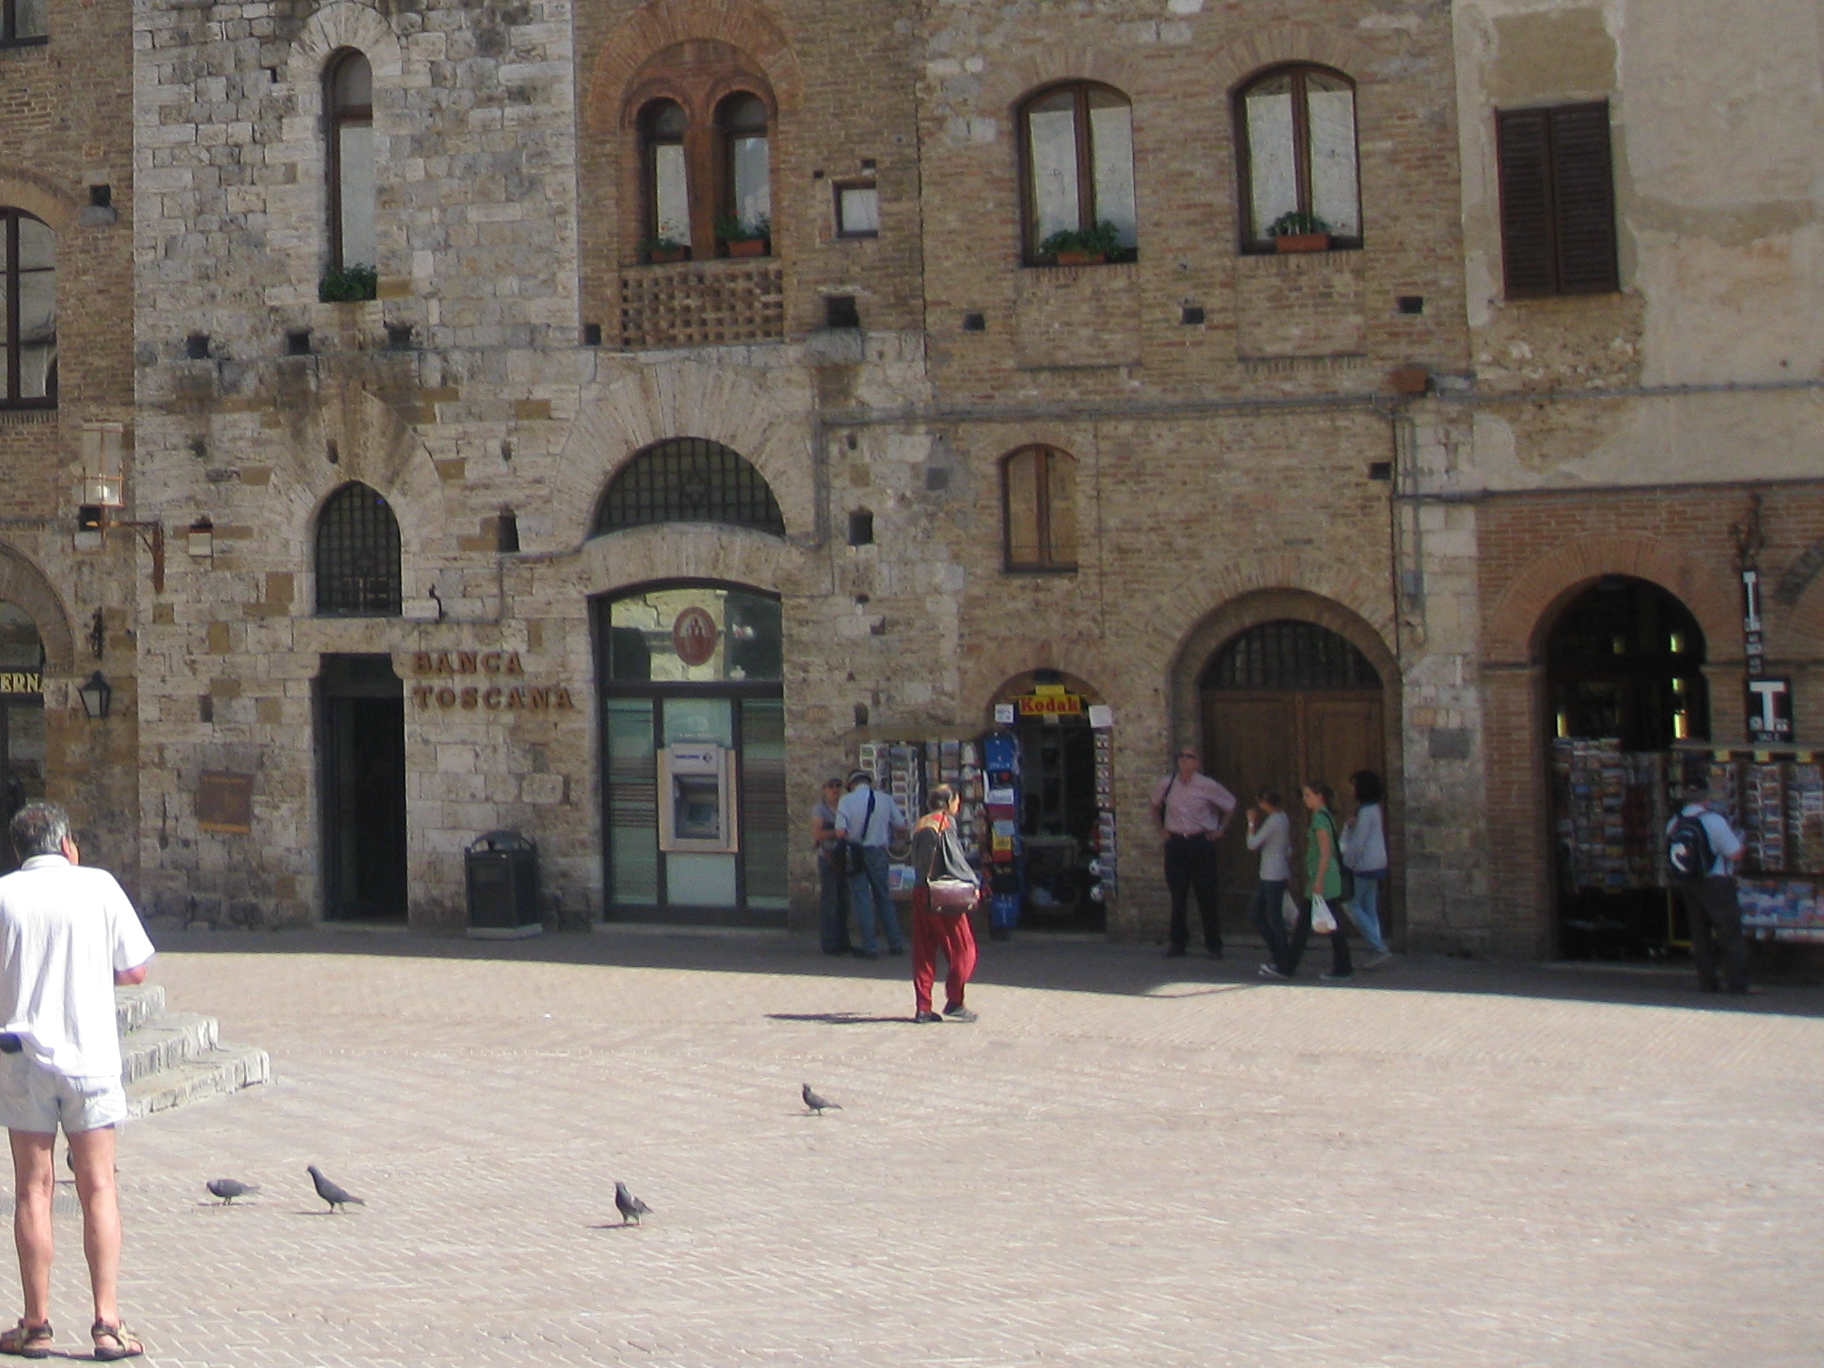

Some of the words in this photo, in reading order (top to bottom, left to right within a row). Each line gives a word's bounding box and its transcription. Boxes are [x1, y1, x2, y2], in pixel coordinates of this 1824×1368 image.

[413, 651, 524, 675] BANCA
[412, 686, 574, 710] TOSCANA
[1020, 697, 1078, 712] Kodak
